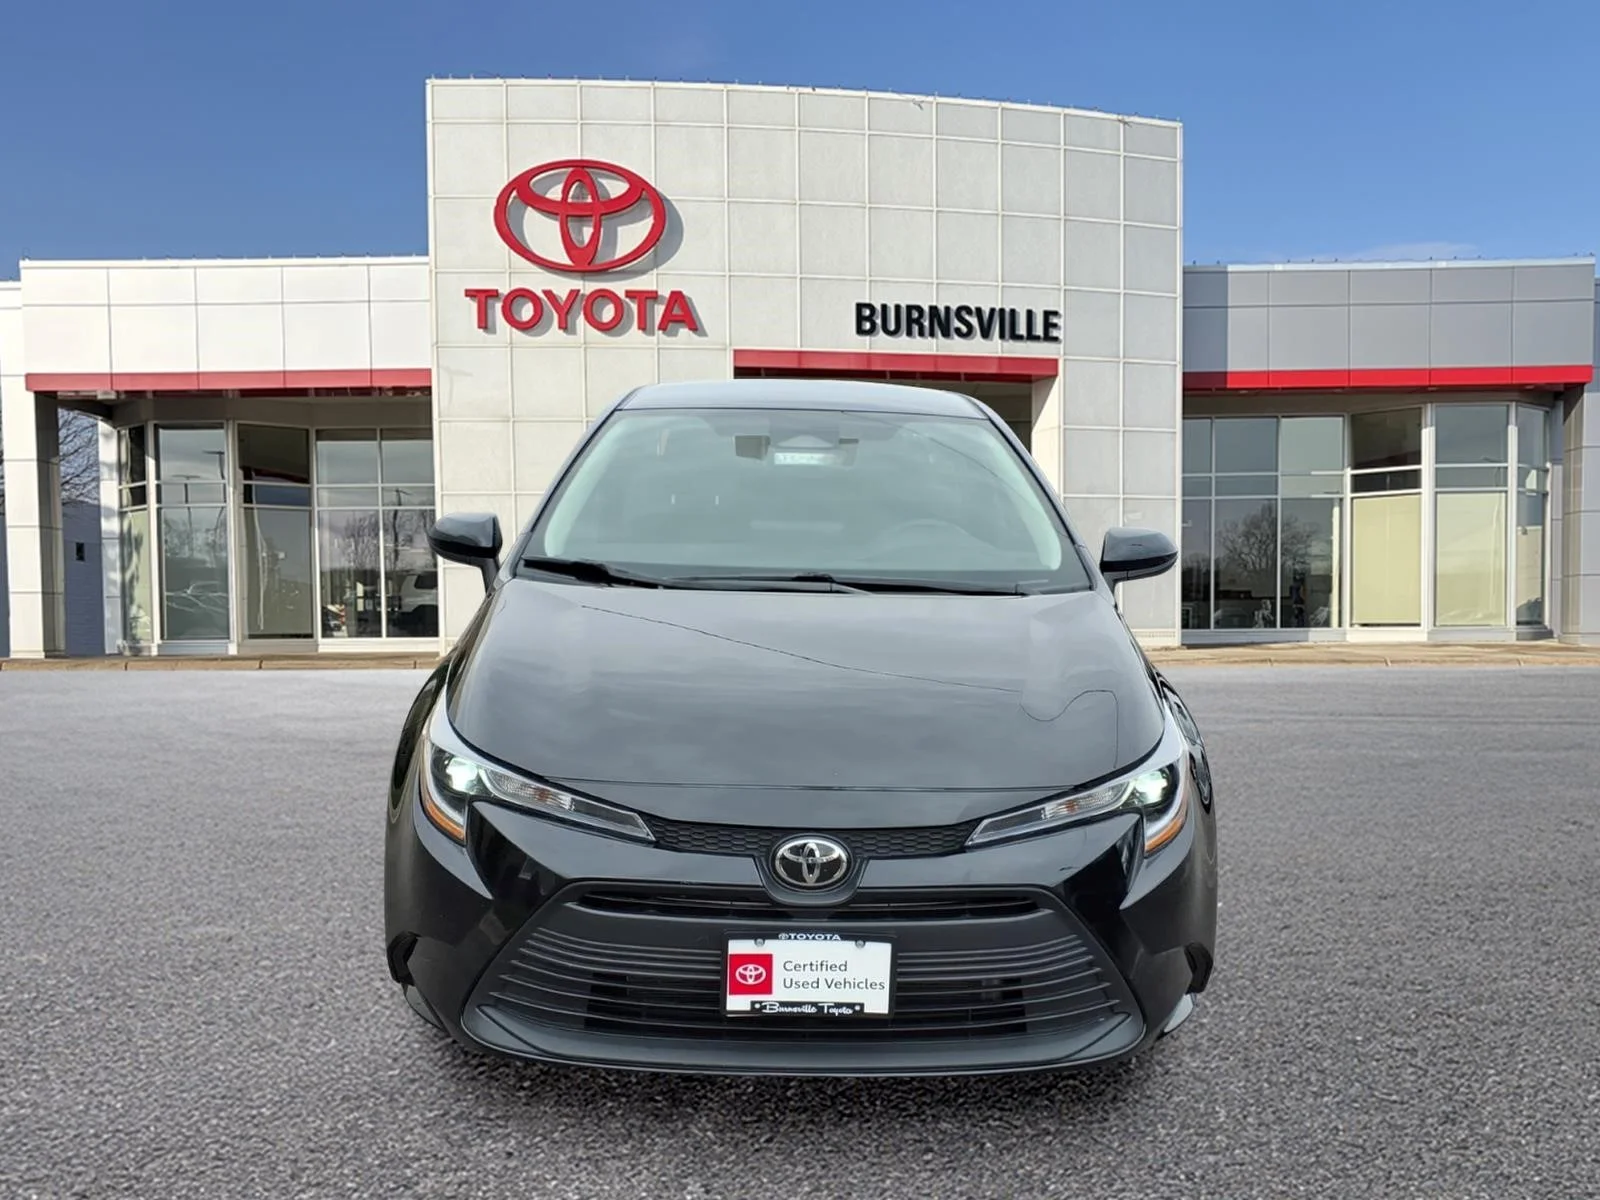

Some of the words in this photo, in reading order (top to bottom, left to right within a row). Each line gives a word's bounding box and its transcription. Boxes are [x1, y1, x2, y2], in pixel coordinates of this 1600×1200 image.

[464, 287, 698, 332] TOYOTA
[855, 302, 1060, 342] BURNSVILLE
[788, 933, 841, 941] TOYOTA
[783, 960, 848, 972] Certified
[783, 977, 820, 989] Used
[824, 977, 885, 990] Vehicles
[761, 1001, 817, 1013] Burnsville
[818, 1003, 853, 1016] Toyota
